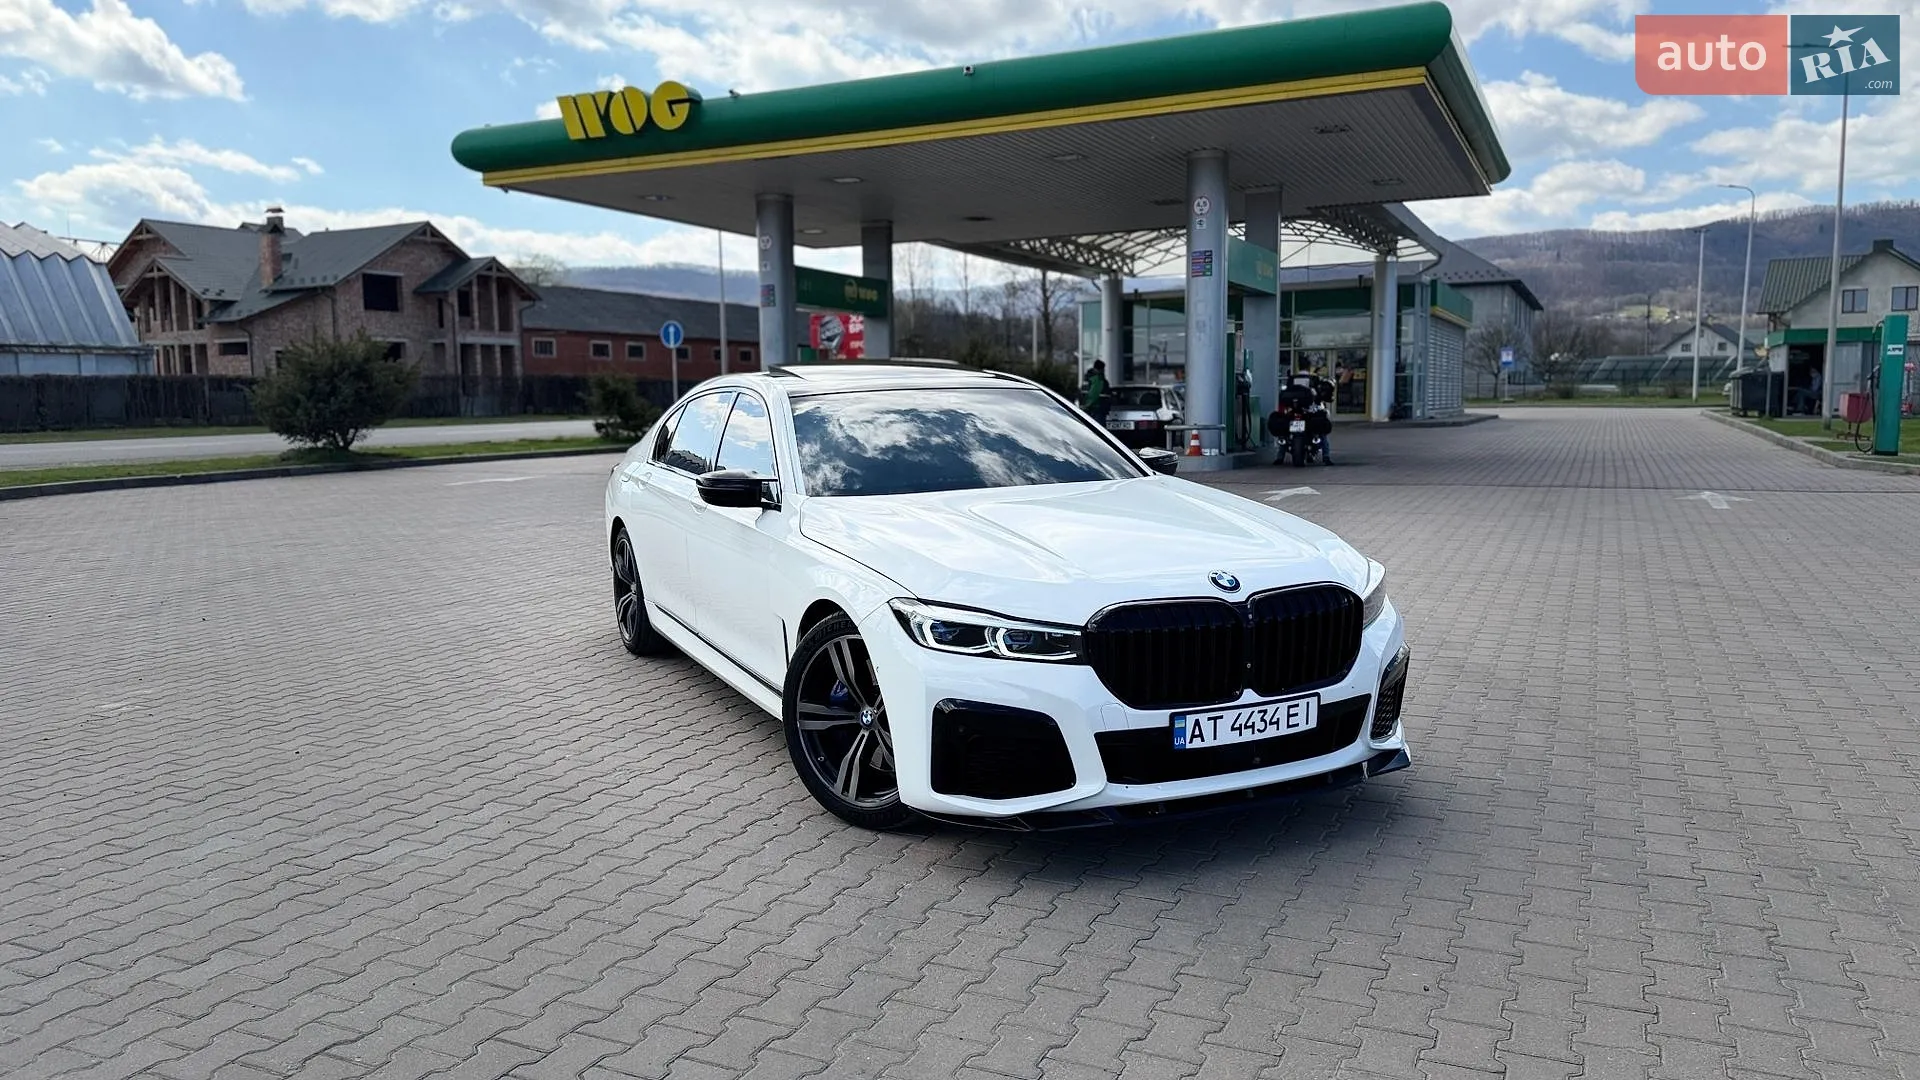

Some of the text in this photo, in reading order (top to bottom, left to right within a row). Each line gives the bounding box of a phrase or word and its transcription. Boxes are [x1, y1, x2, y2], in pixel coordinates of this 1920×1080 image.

[557, 80, 694, 140] WOG
[1174, 737, 1186, 746] UA
[1188, 701, 1311, 744] AT 4434 EI
